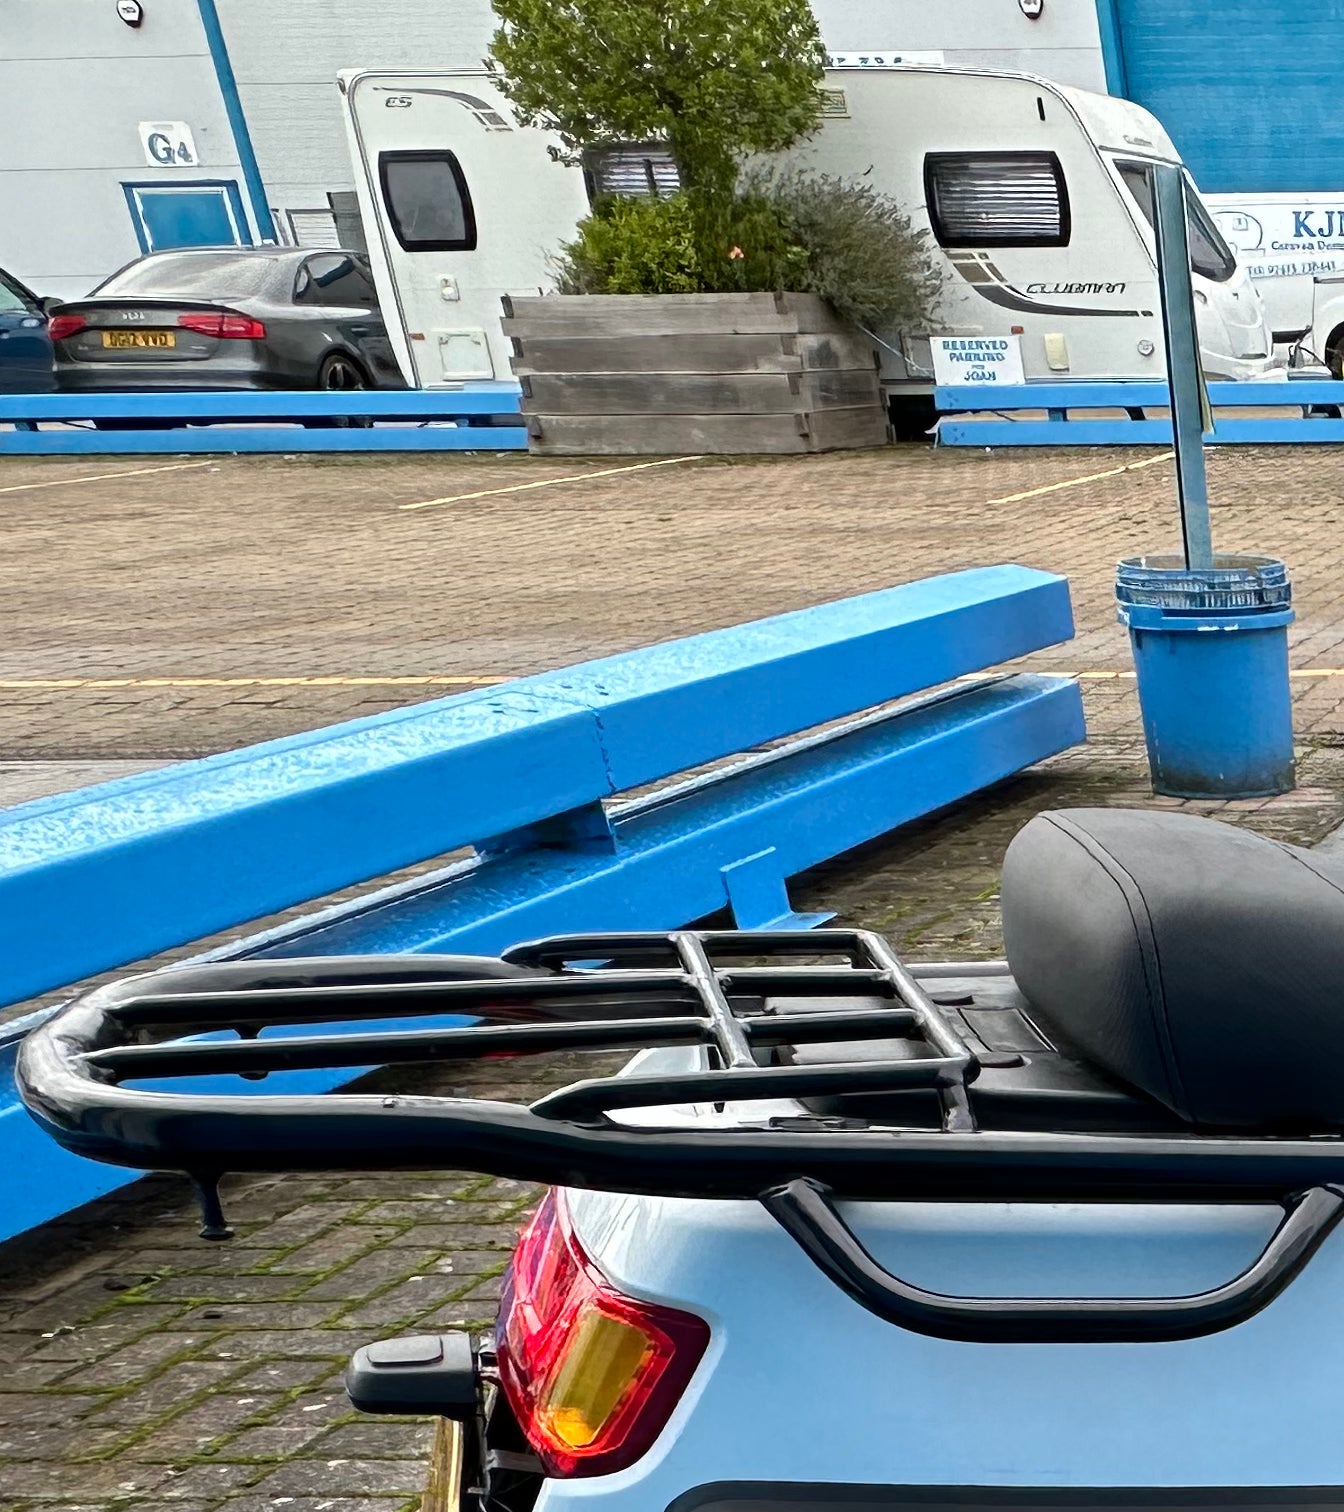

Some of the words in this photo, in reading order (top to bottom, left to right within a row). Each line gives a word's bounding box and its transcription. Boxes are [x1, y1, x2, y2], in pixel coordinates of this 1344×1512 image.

[147, 132, 193, 165] G4
[942, 340, 1009, 350] RESERVED
[949, 352, 1006, 362] PARKING
